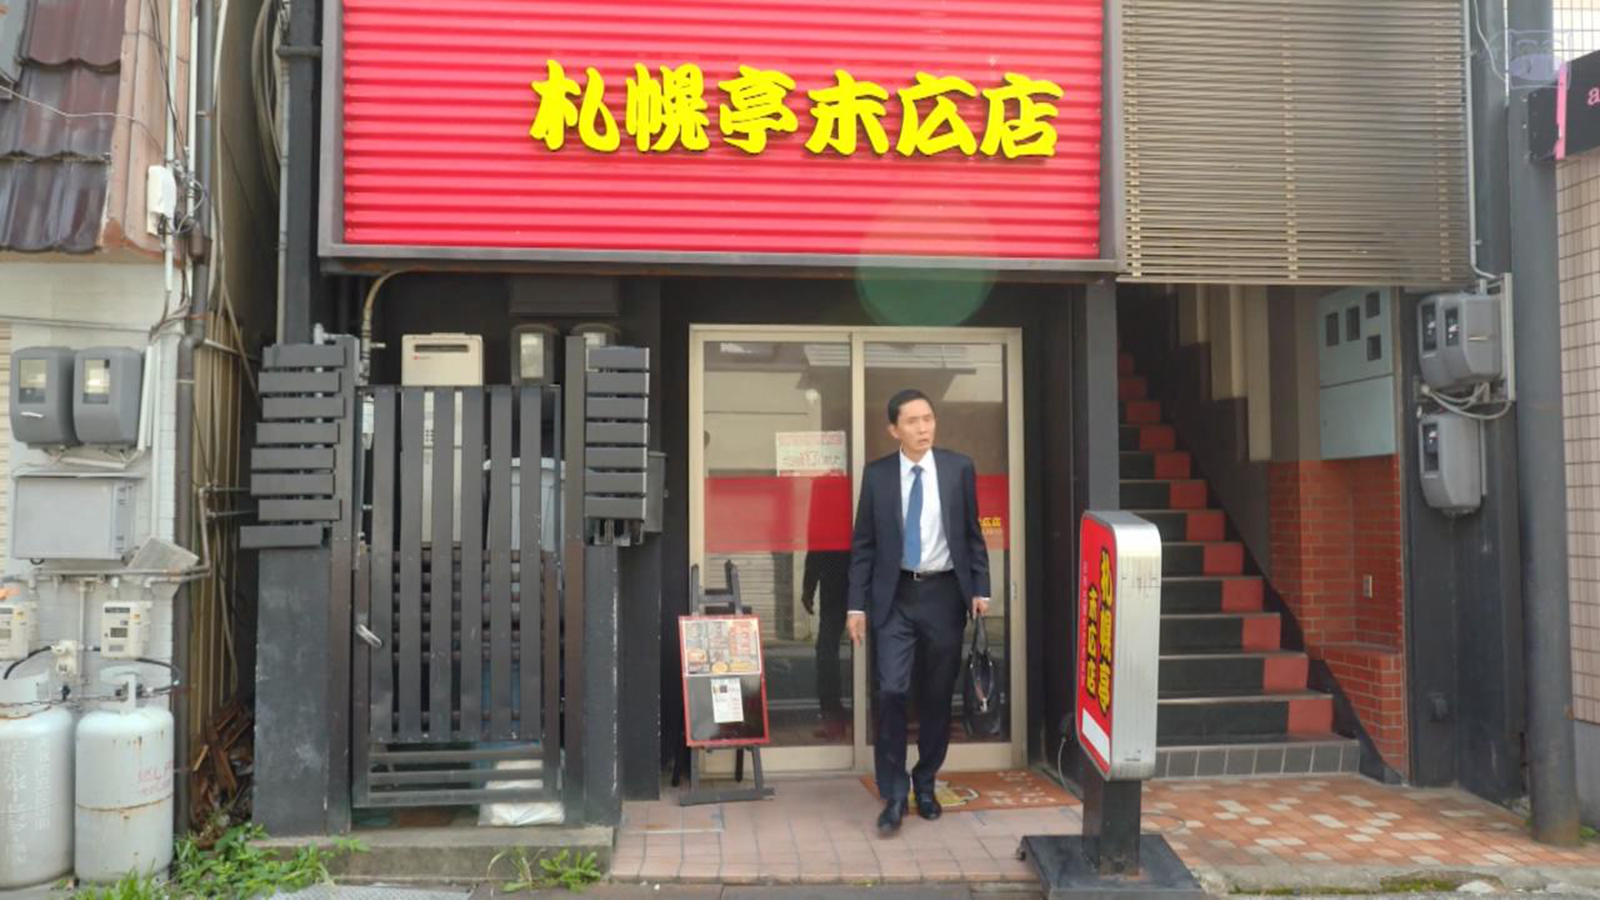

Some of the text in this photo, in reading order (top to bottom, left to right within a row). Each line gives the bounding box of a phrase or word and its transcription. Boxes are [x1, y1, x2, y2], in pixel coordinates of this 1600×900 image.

[530, 59, 1064, 158] 札幌亭末広店
